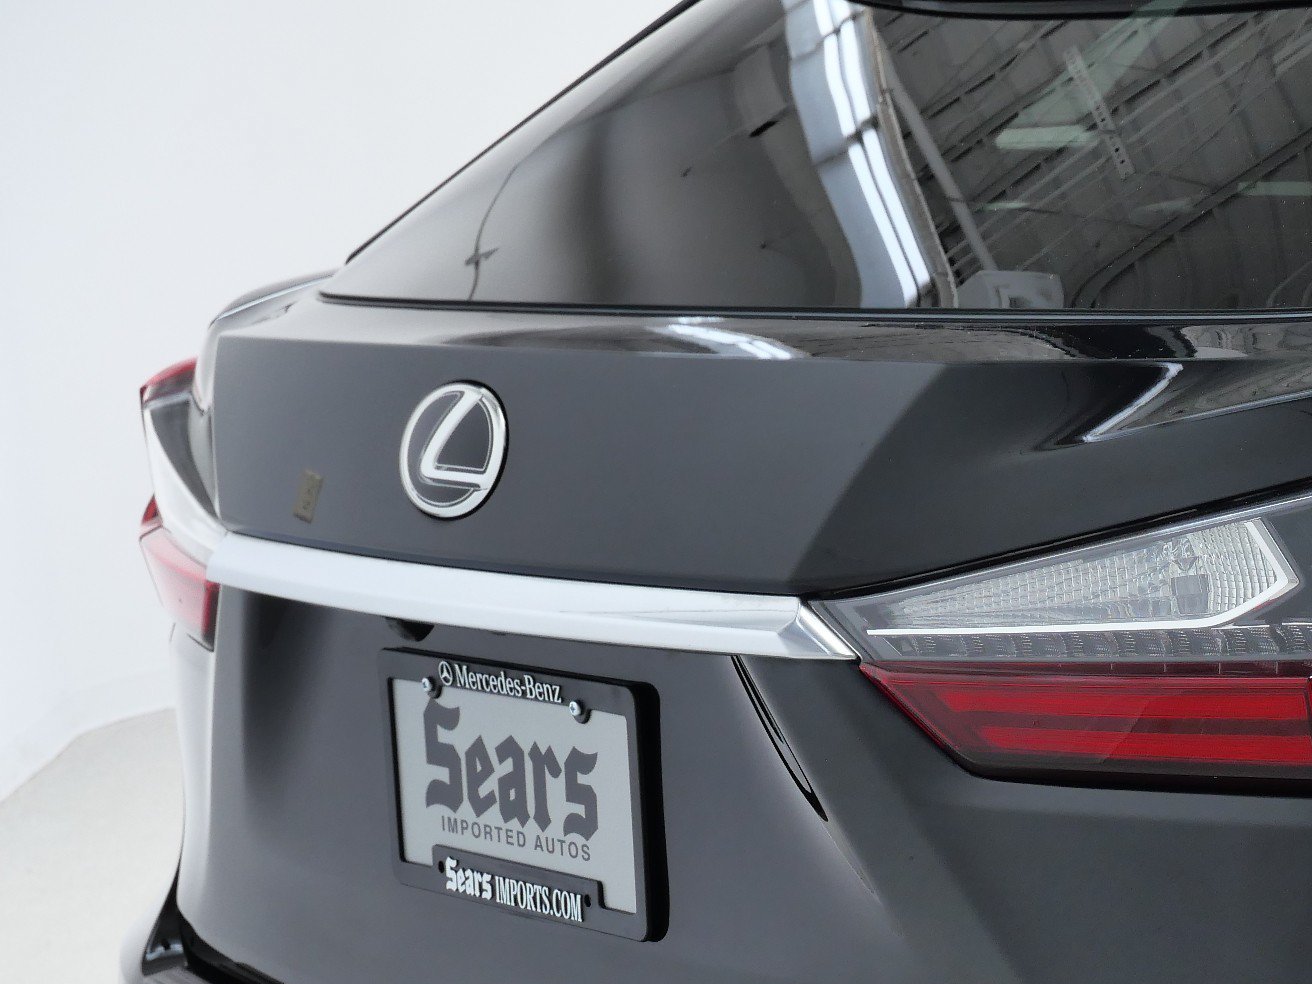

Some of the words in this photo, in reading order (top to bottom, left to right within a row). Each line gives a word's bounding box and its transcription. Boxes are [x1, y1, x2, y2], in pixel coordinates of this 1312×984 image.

[454, 664, 562, 704] Mercedes-Benz
[423, 699, 599, 841] Sears
[441, 816, 527, 848] IMPORTED
[534, 835, 591, 861] AUTOS
[445, 857, 492, 900] Sears
[495, 875, 583, 922] IMPORTS.COM
